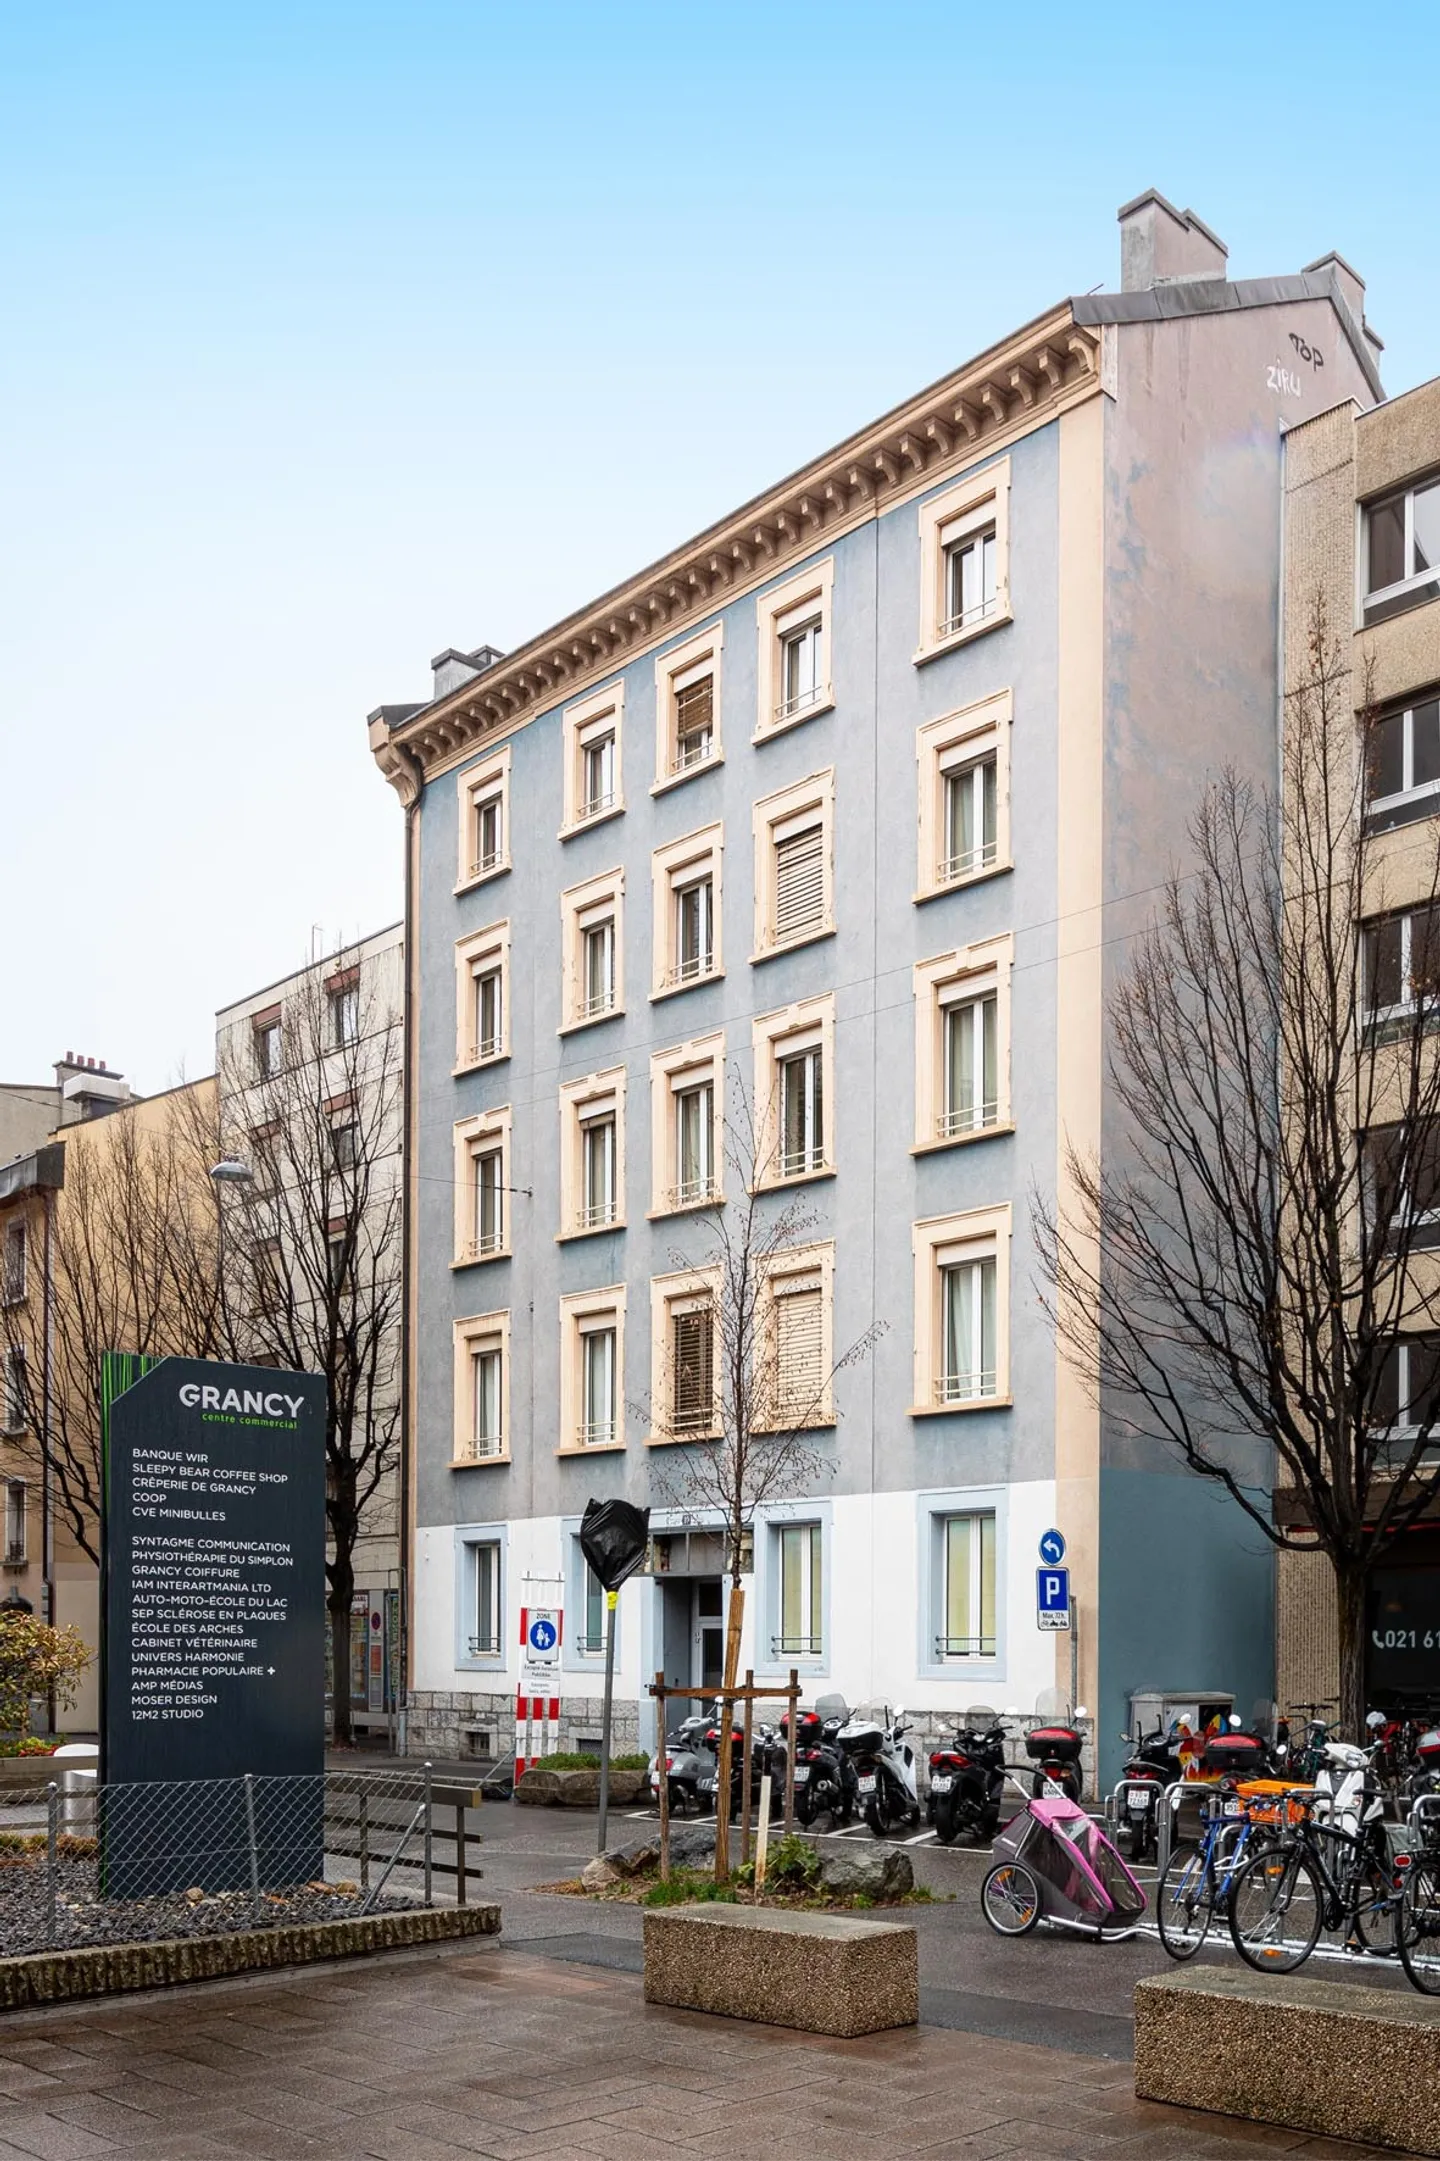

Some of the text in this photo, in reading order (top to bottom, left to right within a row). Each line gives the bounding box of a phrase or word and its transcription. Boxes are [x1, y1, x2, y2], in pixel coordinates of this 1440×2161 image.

[179, 1384, 304, 1418] GRANCY
[202, 1412, 297, 1429] centre commercial
[132, 1449, 208, 1462] BANQUE WIR
[132, 1464, 288, 1483] SLEEPY BEAR COFFEE SHOP
[132, 1477, 256, 1494] CRÊPERIE DE GRANCY
[132, 1492, 166, 1502] COOP
[132, 1507, 225, 1520] CVE MINIBULLES
[132, 1536, 290, 1551] SYNTAGME COMMUNICATION
[132, 1551, 293, 1566] PHYSIOTHÉRAPIE DU SIMPLON
[132, 1565, 240, 1577] GRANCY COIFFURE
[132, 1580, 271, 1592] IAM INTERARTMANIA LTD
[1046, 1577, 1059, 1605] P
[133, 1595, 288, 1607] AUTO-MOTO-ÉCOLE DU LAC
[132, 1608, 286, 1621] SEP SCLÉROSE EN PLAQUES
[132, 1622, 243, 1634] ÉCOLE DES ARCHES
[132, 1637, 258, 1648] CABINET VÉTÉRINAIRE
[1385, 1630, 1415, 1648] 021
[132, 1653, 244, 1662] UNIVERS HARMONIE
[132, 1667, 263, 1676] PHARMACIE POPULAIRE
[132, 1680, 203, 1690] AMP MÉDIAS
[132, 1695, 217, 1704] MOSER DESIGN
[132, 1709, 203, 1719] 12M2 STUDIO
